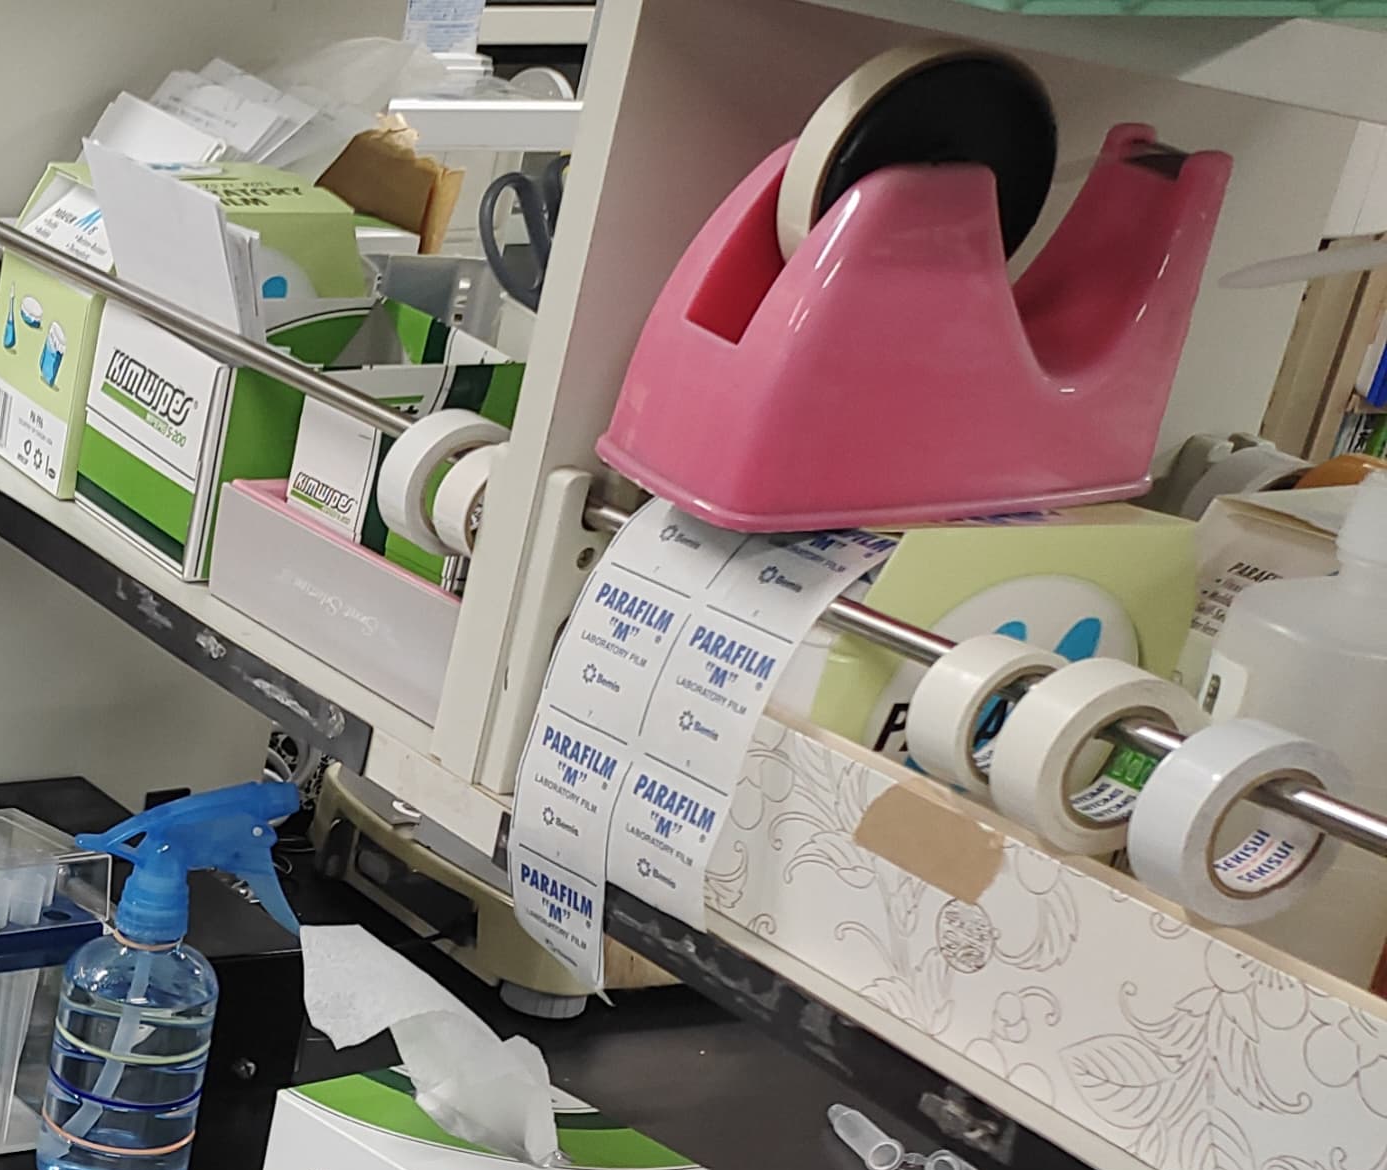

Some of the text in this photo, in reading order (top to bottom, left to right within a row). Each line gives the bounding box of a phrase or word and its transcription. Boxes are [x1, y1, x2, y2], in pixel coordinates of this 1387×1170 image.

[595, 582, 675, 634] PARAFILM
[581, 629, 648, 668] LABORATORY FILM
[689, 625, 776, 681] PARAFILM
[595, 672, 621, 693] Bemis
[676, 677, 747, 716] LABORATORY FILM
[694, 719, 719, 742] Bemis
[542, 725, 618, 781] PARAFILM
[534, 773, 598, 814] LABORATORY FILM
[633, 774, 716, 833] PARAFILM
[555, 816, 579, 837] Bemis
[626, 823, 674, 856] LABORATORY
[1212, 829, 1271, 872] SEKISUI
[1236, 840, 1295, 883] SEKISUI
[520, 863, 593, 919] PARAFILM
[651, 867, 676, 890] Bemis
